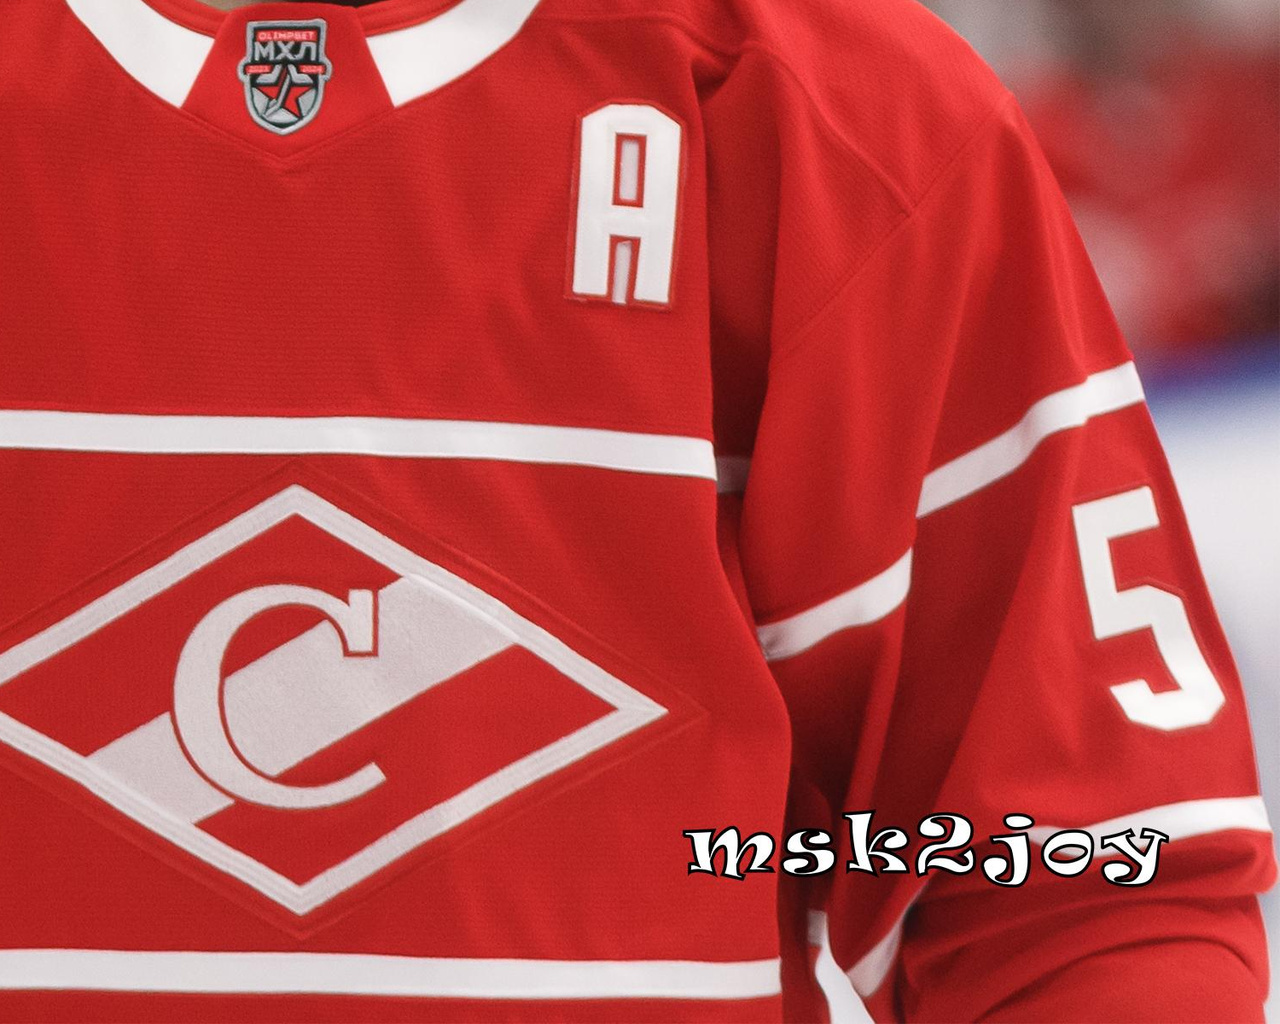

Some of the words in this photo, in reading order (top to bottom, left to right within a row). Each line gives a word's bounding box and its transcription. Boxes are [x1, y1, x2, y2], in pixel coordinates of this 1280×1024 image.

[254, 41, 317, 61] МХЛ
[571, 102, 683, 304] A
[1071, 485, 1226, 732] 5
